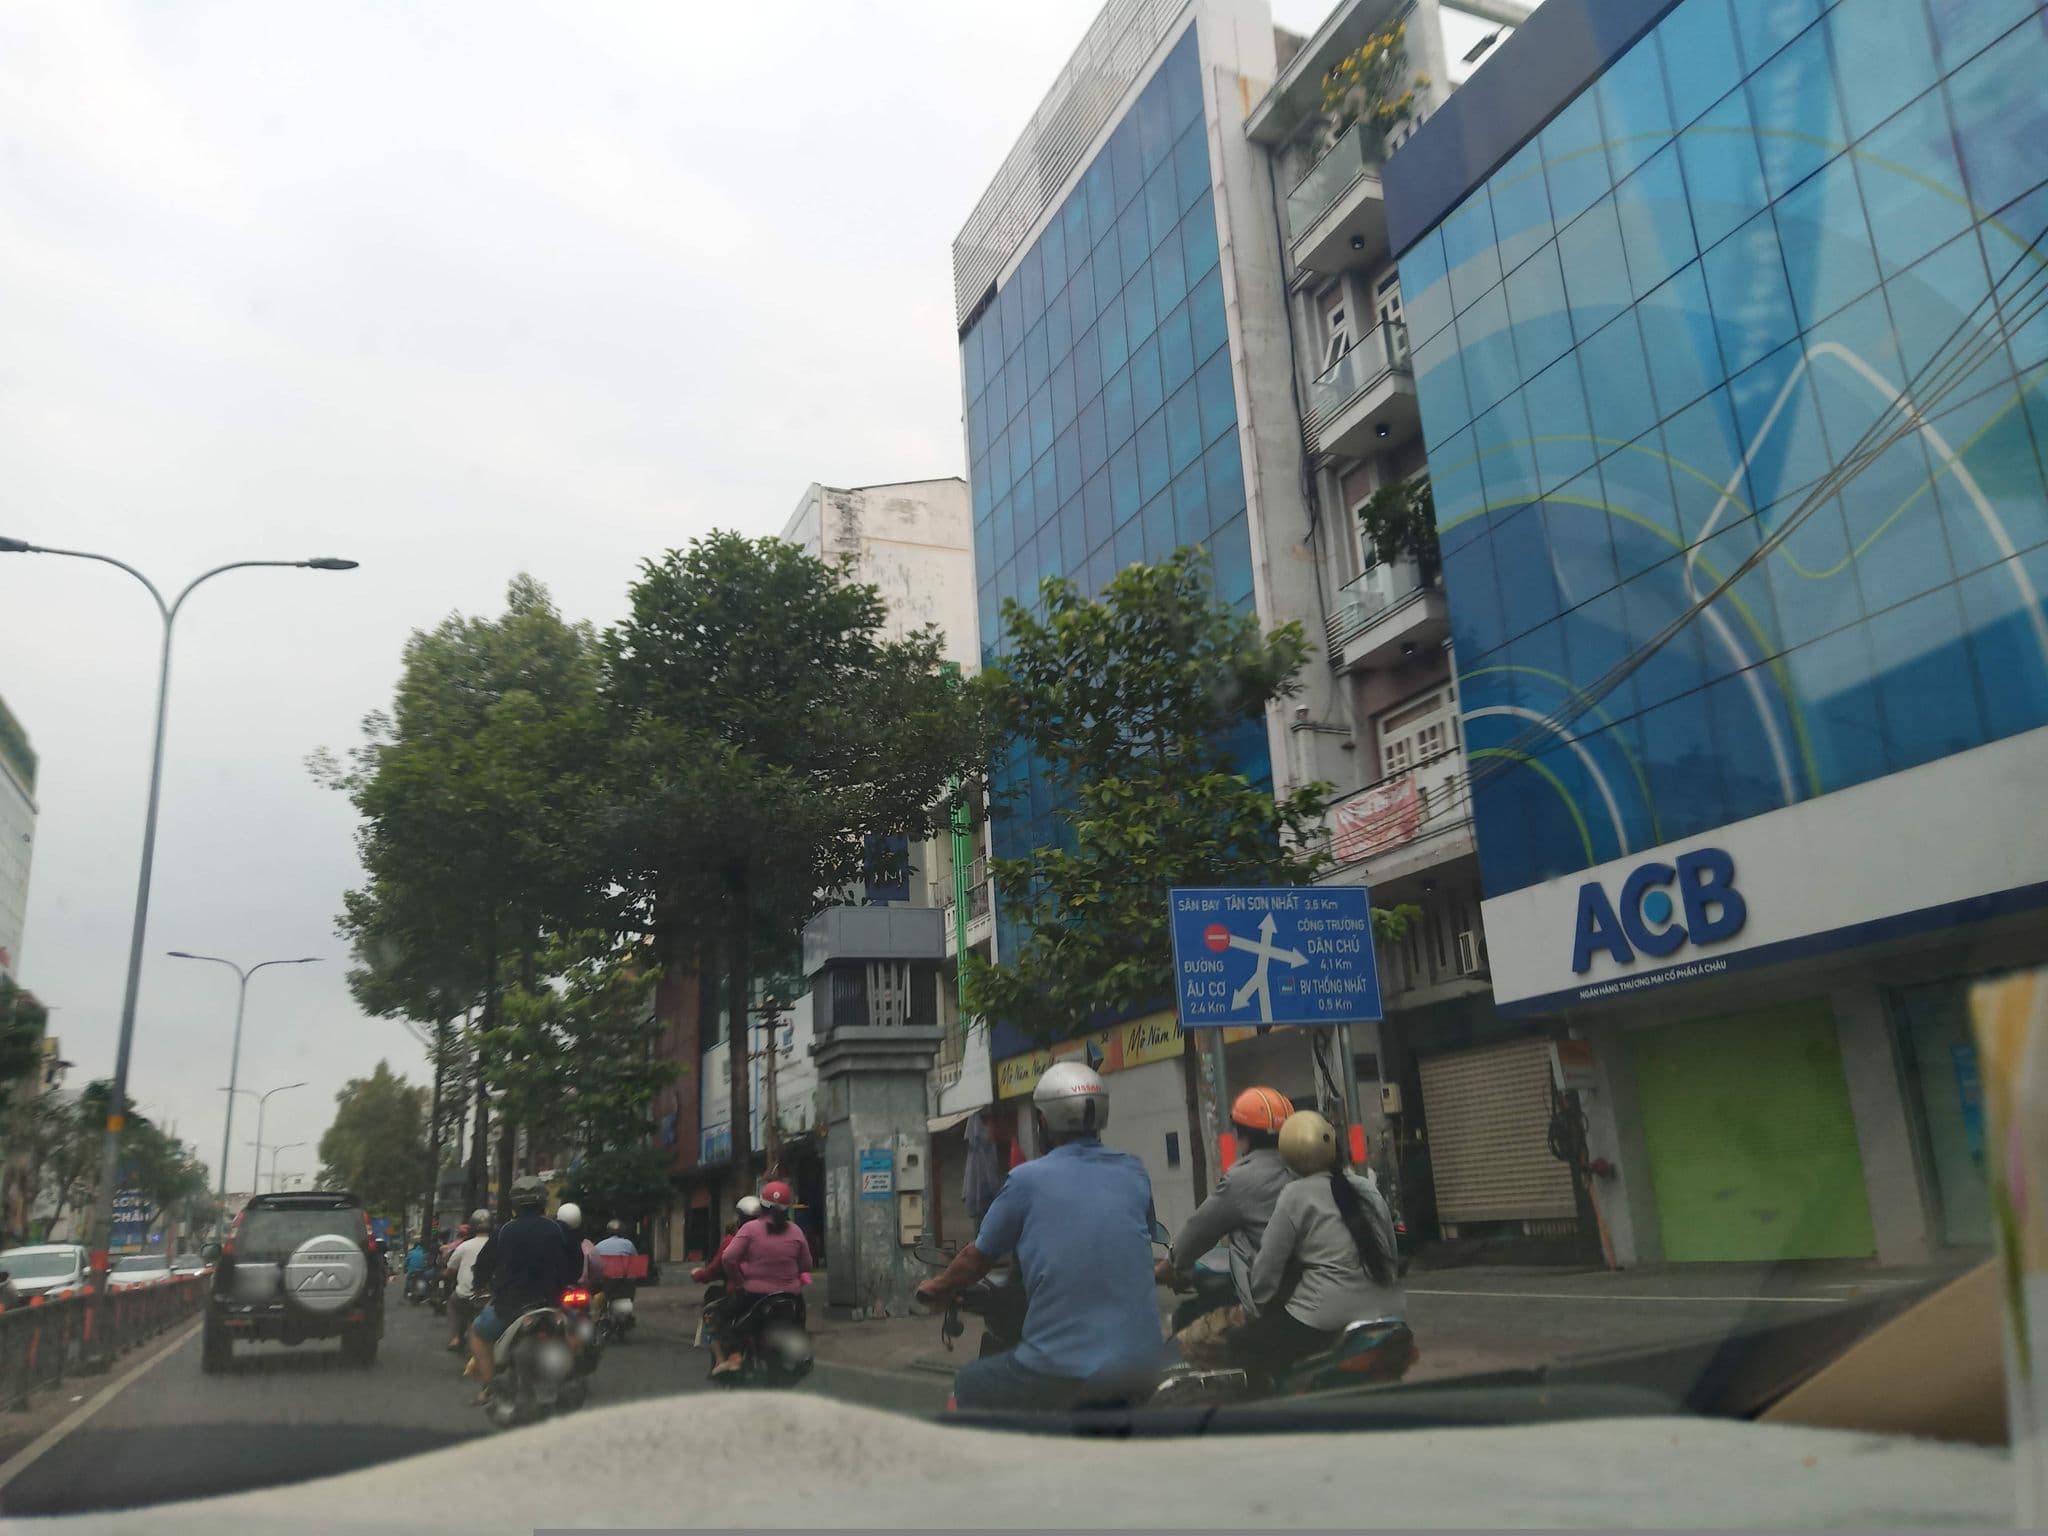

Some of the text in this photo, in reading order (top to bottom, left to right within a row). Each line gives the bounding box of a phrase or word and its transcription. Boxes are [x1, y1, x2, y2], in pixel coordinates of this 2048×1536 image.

[1178, 897, 1199, 911] SÂN
[1202, 899, 1220, 911] BAY
[1224, 894, 1245, 911] TÂN
[1247, 896, 1269, 911] SƠN
[1271, 891, 1299, 910] NHẤT
[1321, 899, 1338, 910] Km
[1572, 848, 1747, 973] ACB
[1297, 917, 1365, 931] CÔNG TRƯỜNG
[1307, 934, 1360, 954] DÂN CHỦ
[1184, 957, 1224, 973] ĐƯỜNG
[1335, 958, 1352, 970] Km
[1187, 979, 1226, 997] ÂU CƠ
[1300, 973, 1367, 995] BV THỐNG NHẤT
[1579, 987, 1599, 1000] NGÂN
[1599, 983, 1620, 995] HÀNG
[1619, 976, 1650, 991] THƯƠNG
[1698, 963, 1706, 975] Á
[1704, 960, 1727, 973] CHÂU
[1208, 1001, 1225, 1014] Km
[1335, 998, 1352, 1011] Km
